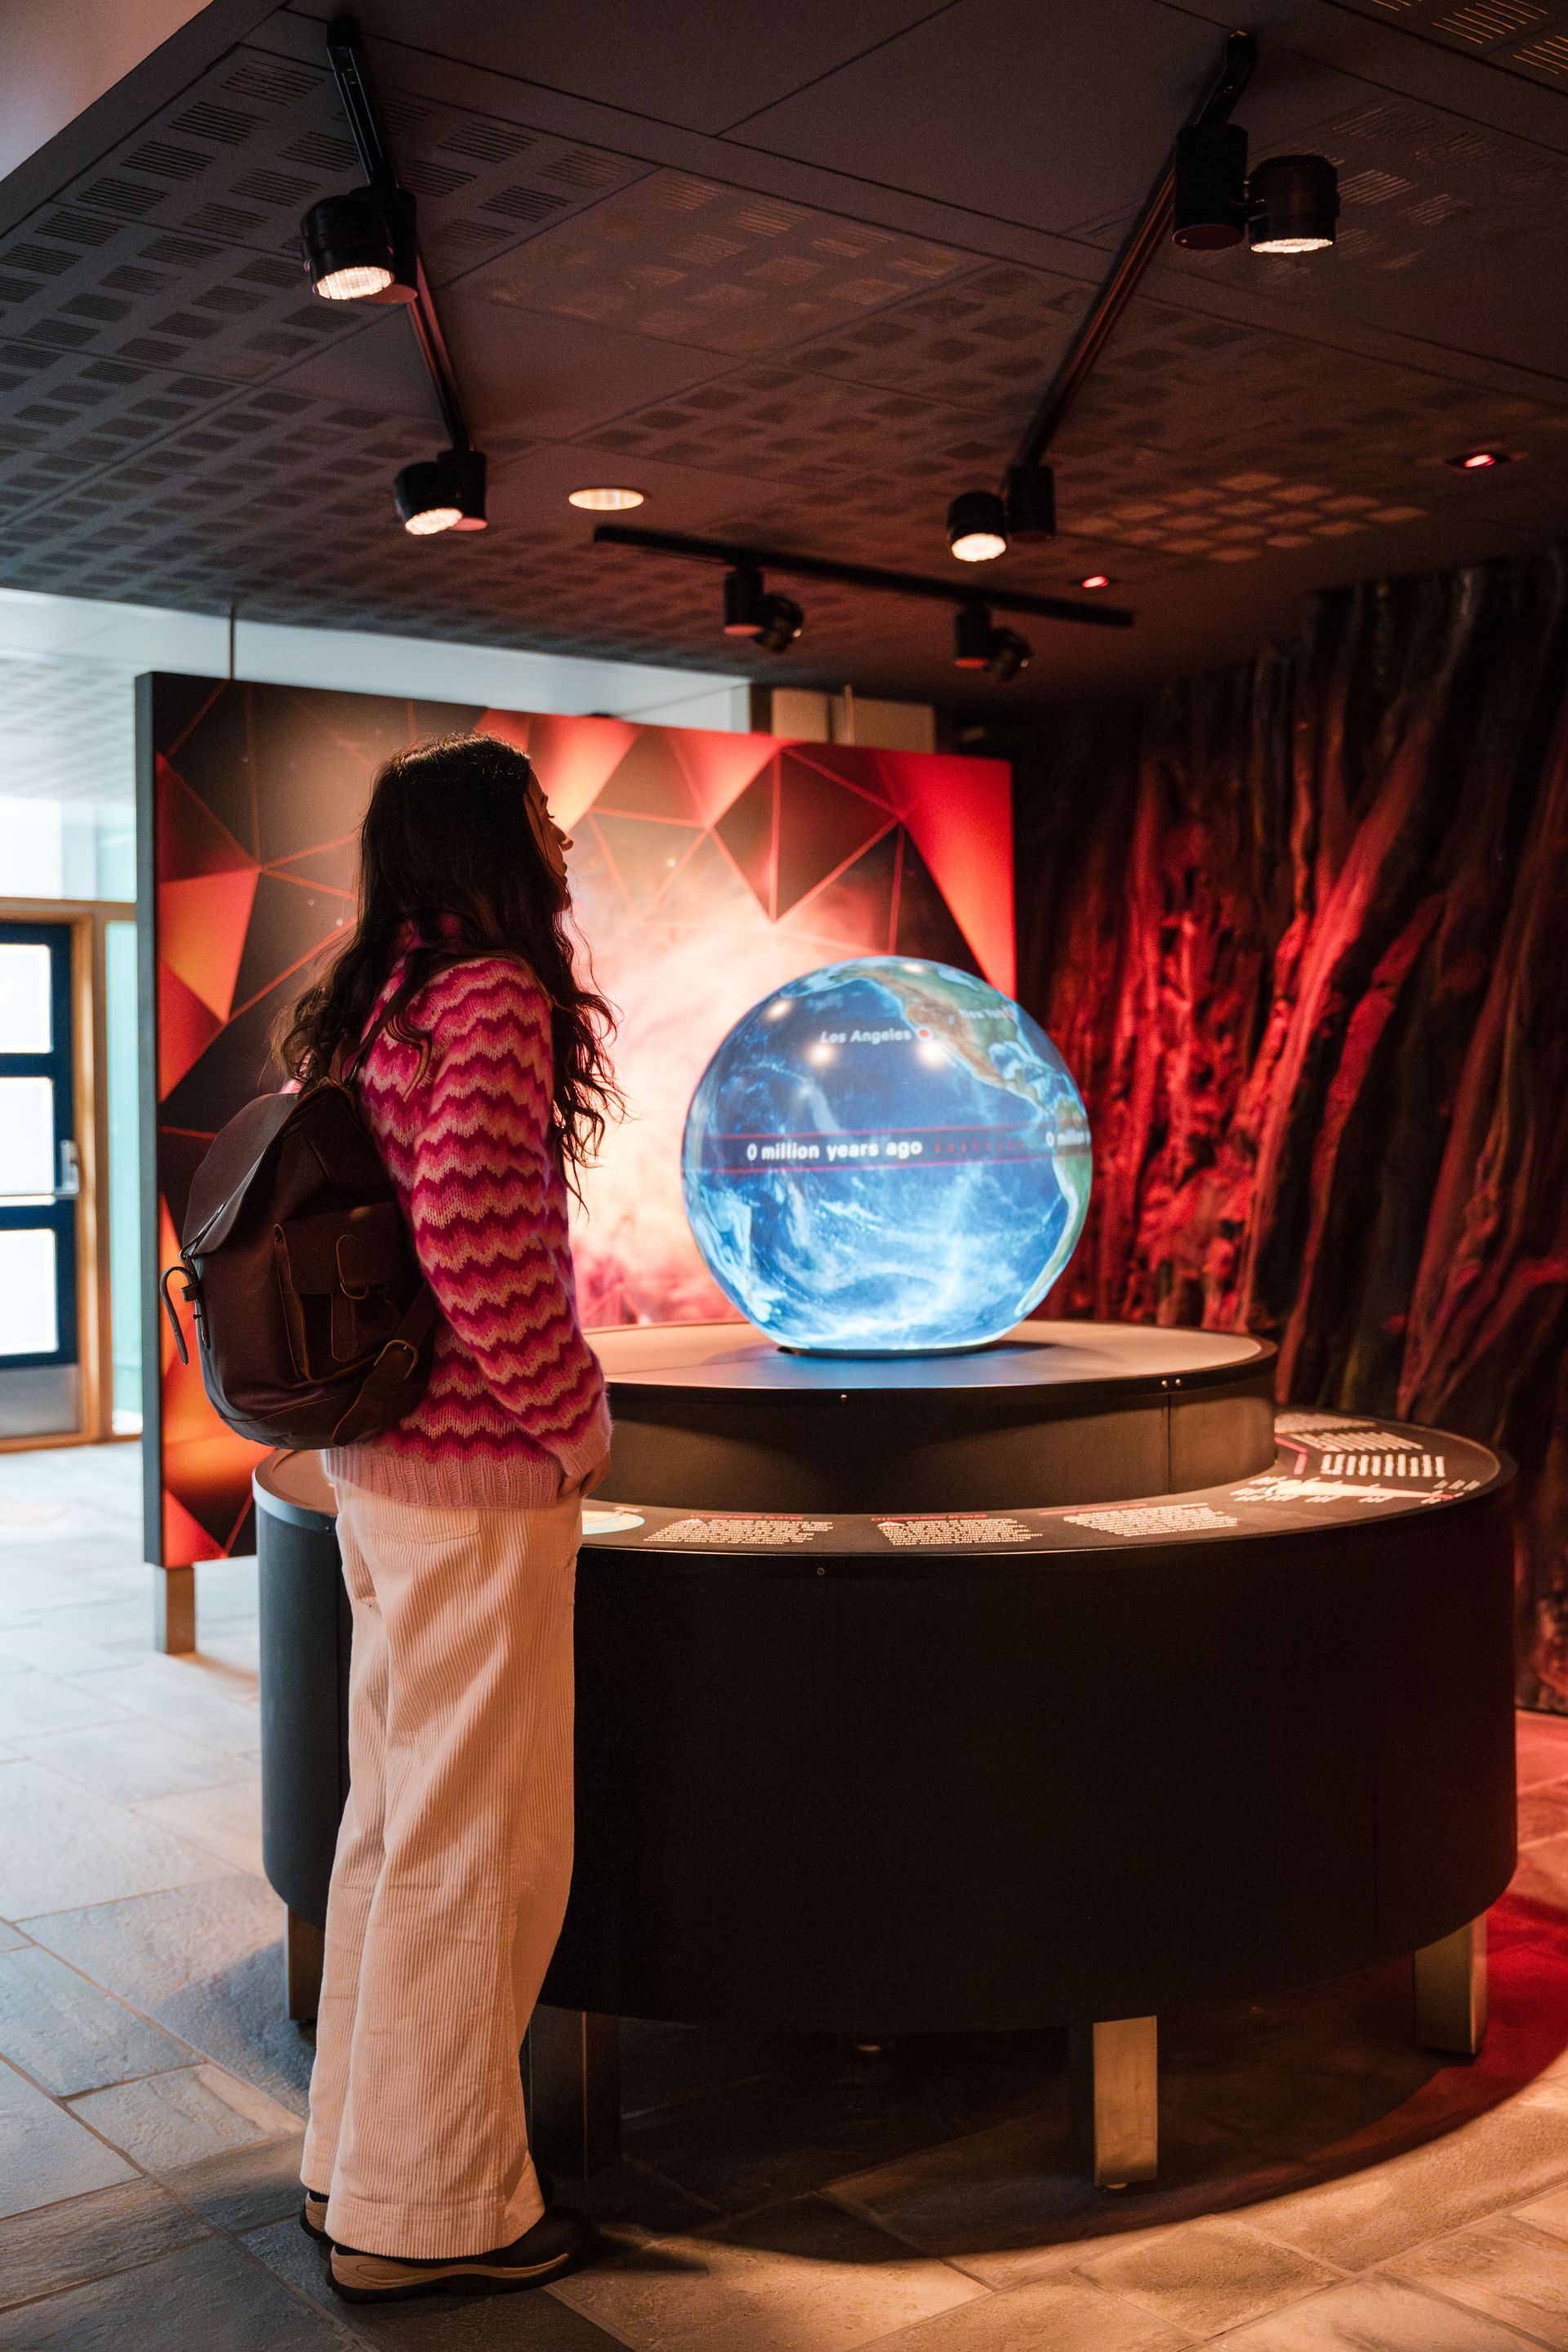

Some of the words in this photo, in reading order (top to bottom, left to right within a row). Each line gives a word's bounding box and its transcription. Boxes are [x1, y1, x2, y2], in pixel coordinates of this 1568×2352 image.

[820, 1031, 847, 1044] Los
[850, 1028, 912, 1045] Angeles
[746, 1143, 758, 1161] 0
[761, 1142, 820, 1160] million
[826, 1142, 880, 1162] years
[885, 1141, 923, 1160] ago
